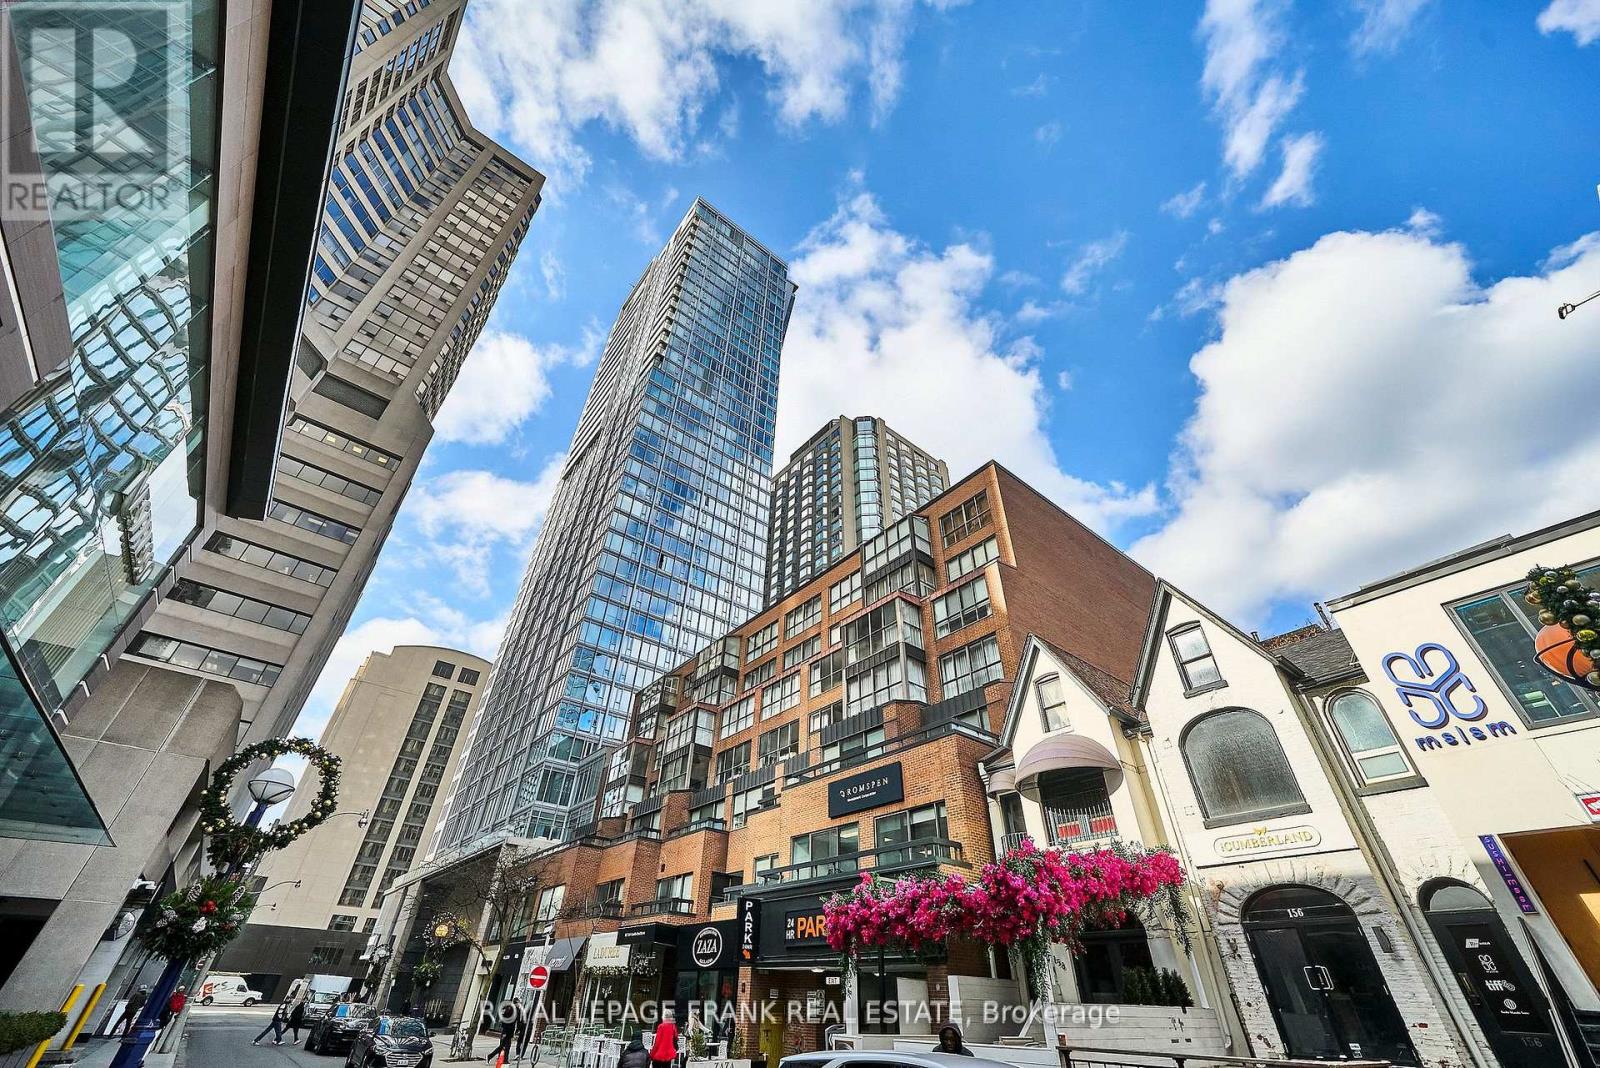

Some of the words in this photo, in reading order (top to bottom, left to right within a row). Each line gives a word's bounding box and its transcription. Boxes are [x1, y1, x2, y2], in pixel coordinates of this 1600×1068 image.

[1287, 908, 1304, 918] 156
[743, 901, 754, 944] PARK
[786, 918, 795, 929] 24
[796, 915, 830, 939] PAR
[785, 930, 795, 940] HR
[696, 938, 718, 954] ZAZA
